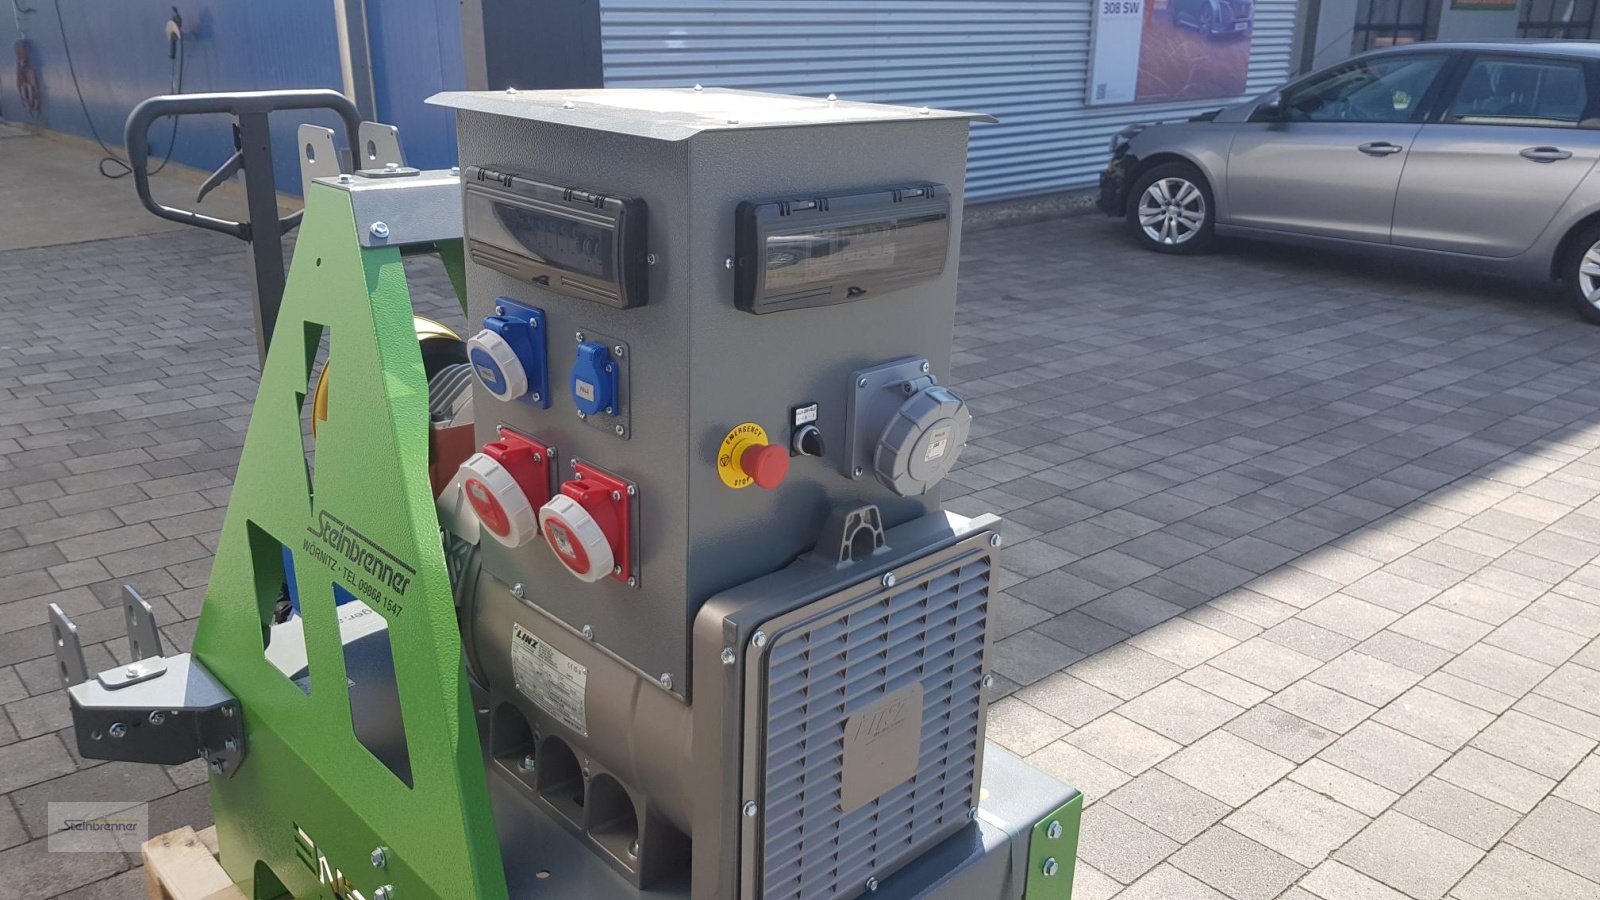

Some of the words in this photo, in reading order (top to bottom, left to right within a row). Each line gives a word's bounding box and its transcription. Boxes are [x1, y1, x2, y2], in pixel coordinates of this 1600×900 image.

[1104, 2, 1121, 14] 308
[1123, 2, 1140, 13] SW
[725, 425, 762, 445] EMERGENCY
[307, 509, 416, 596] Steinbrenner
[342, 566, 357, 587] TEL
[383, 597, 403, 617] 1547
[516, 630, 539, 649] LINZ
